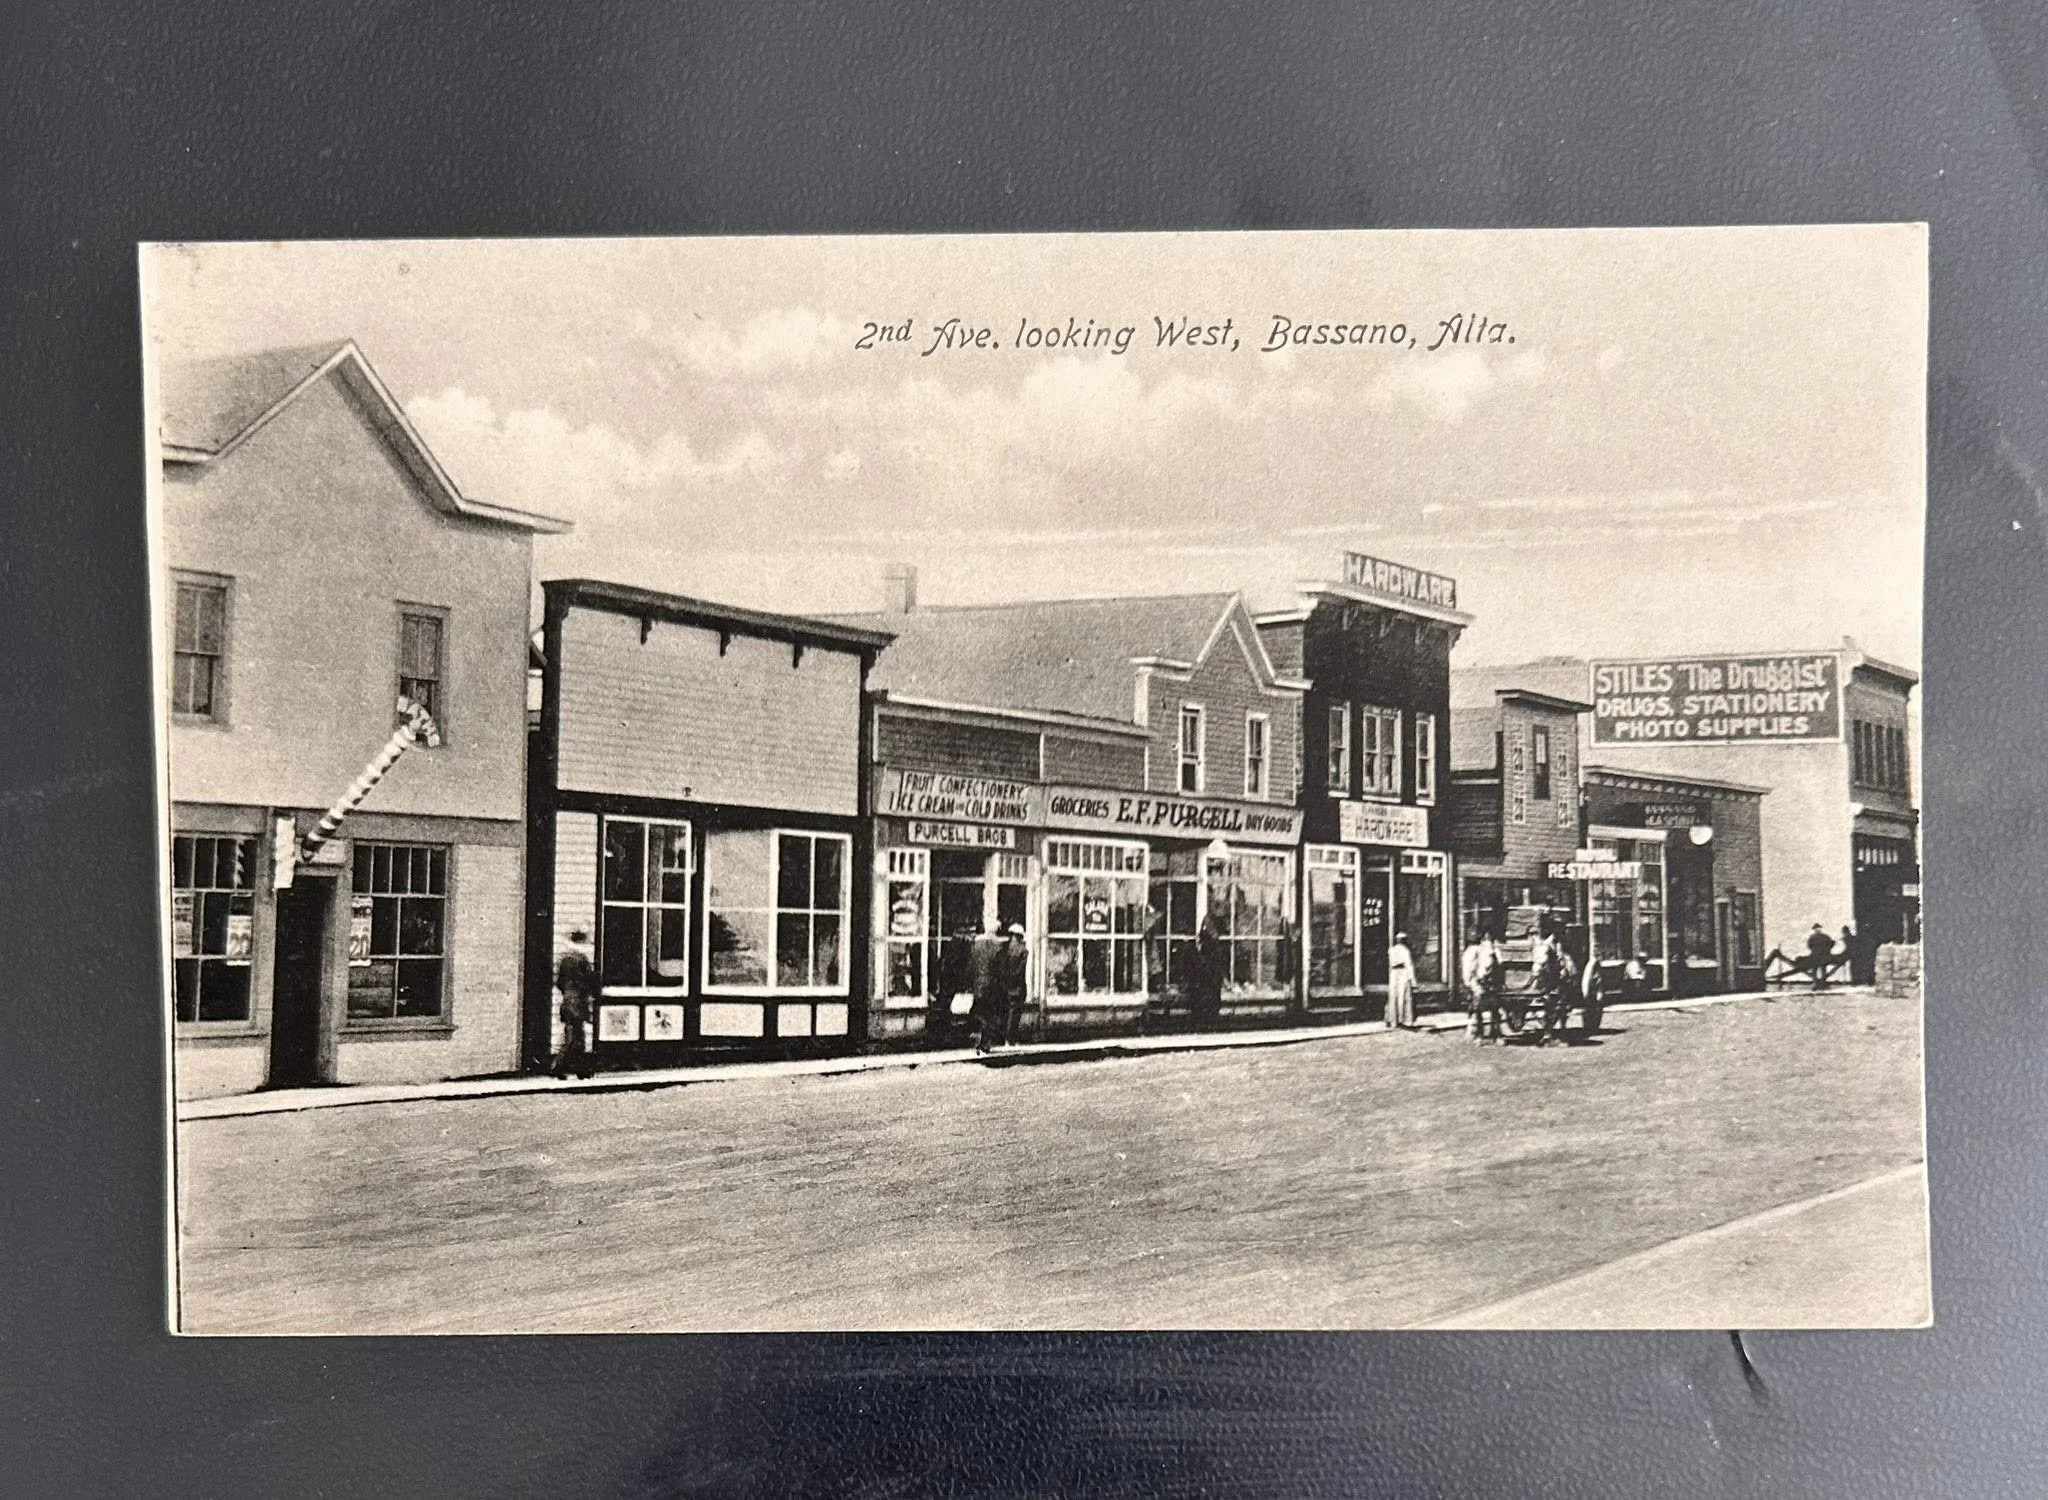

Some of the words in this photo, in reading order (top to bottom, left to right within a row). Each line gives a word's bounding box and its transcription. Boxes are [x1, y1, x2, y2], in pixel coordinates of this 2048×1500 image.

[855, 318, 912, 349] 2nd
[921, 317, 1000, 356] Ave.
[1015, 317, 1136, 354] looking
[1153, 315, 1242, 351] West,
[1260, 314, 1418, 351] Bassano,
[1427, 312, 1518, 350] Alta.
[1347, 554, 1454, 605] HARDWARE
[1596, 664, 1674, 695] STILES
[1682, 691, 1831, 715] STATIONERY
[1613, 720, 1690, 739] PHOTO
[1696, 716, 1810, 737] SUPPLIES
[904, 772, 935, 792] FRUIT
[918, 793, 955, 815] CREAM
[965, 798, 991, 819] COLD
[992, 801, 1028, 821] DRINKS
[1050, 796, 1110, 819] GROCERIES
[1152, 801, 1243, 832] PURCELL
[914, 823, 971, 843] PURCELL
[1547, 861, 1642, 880] RESTAURANT
